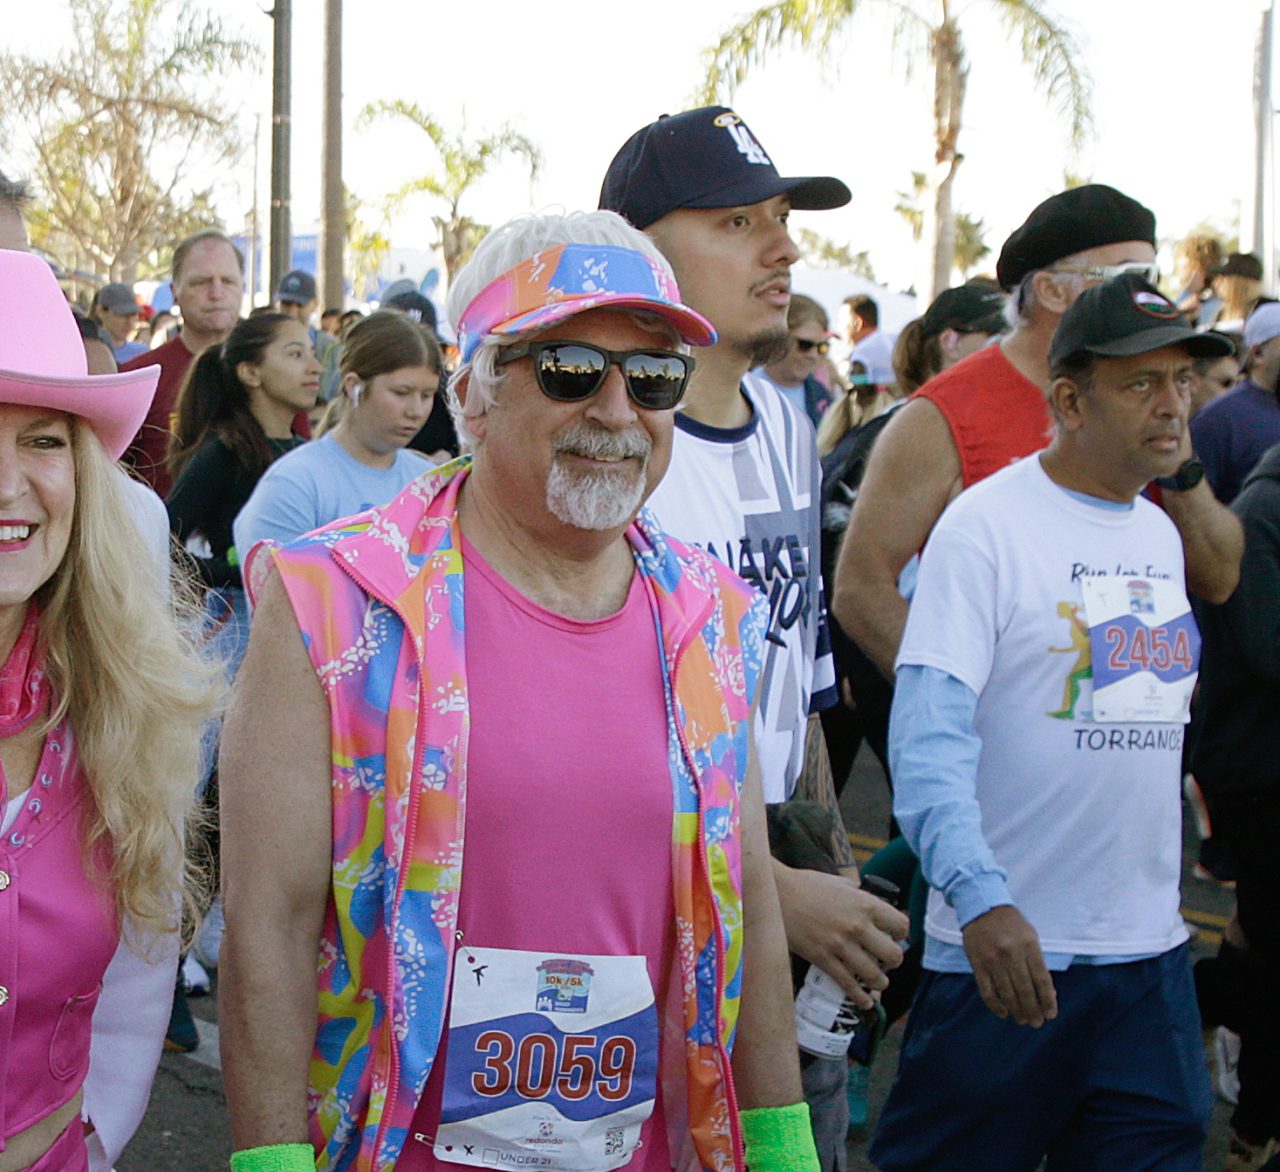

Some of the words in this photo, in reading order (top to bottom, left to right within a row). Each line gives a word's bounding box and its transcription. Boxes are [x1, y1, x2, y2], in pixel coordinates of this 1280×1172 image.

[1106, 625, 1193, 671] 2454
[1073, 728, 1182, 751] TORRANCE
[471, 1030, 637, 1101] 3059
[500, 1152, 539, 1164] UNDER
